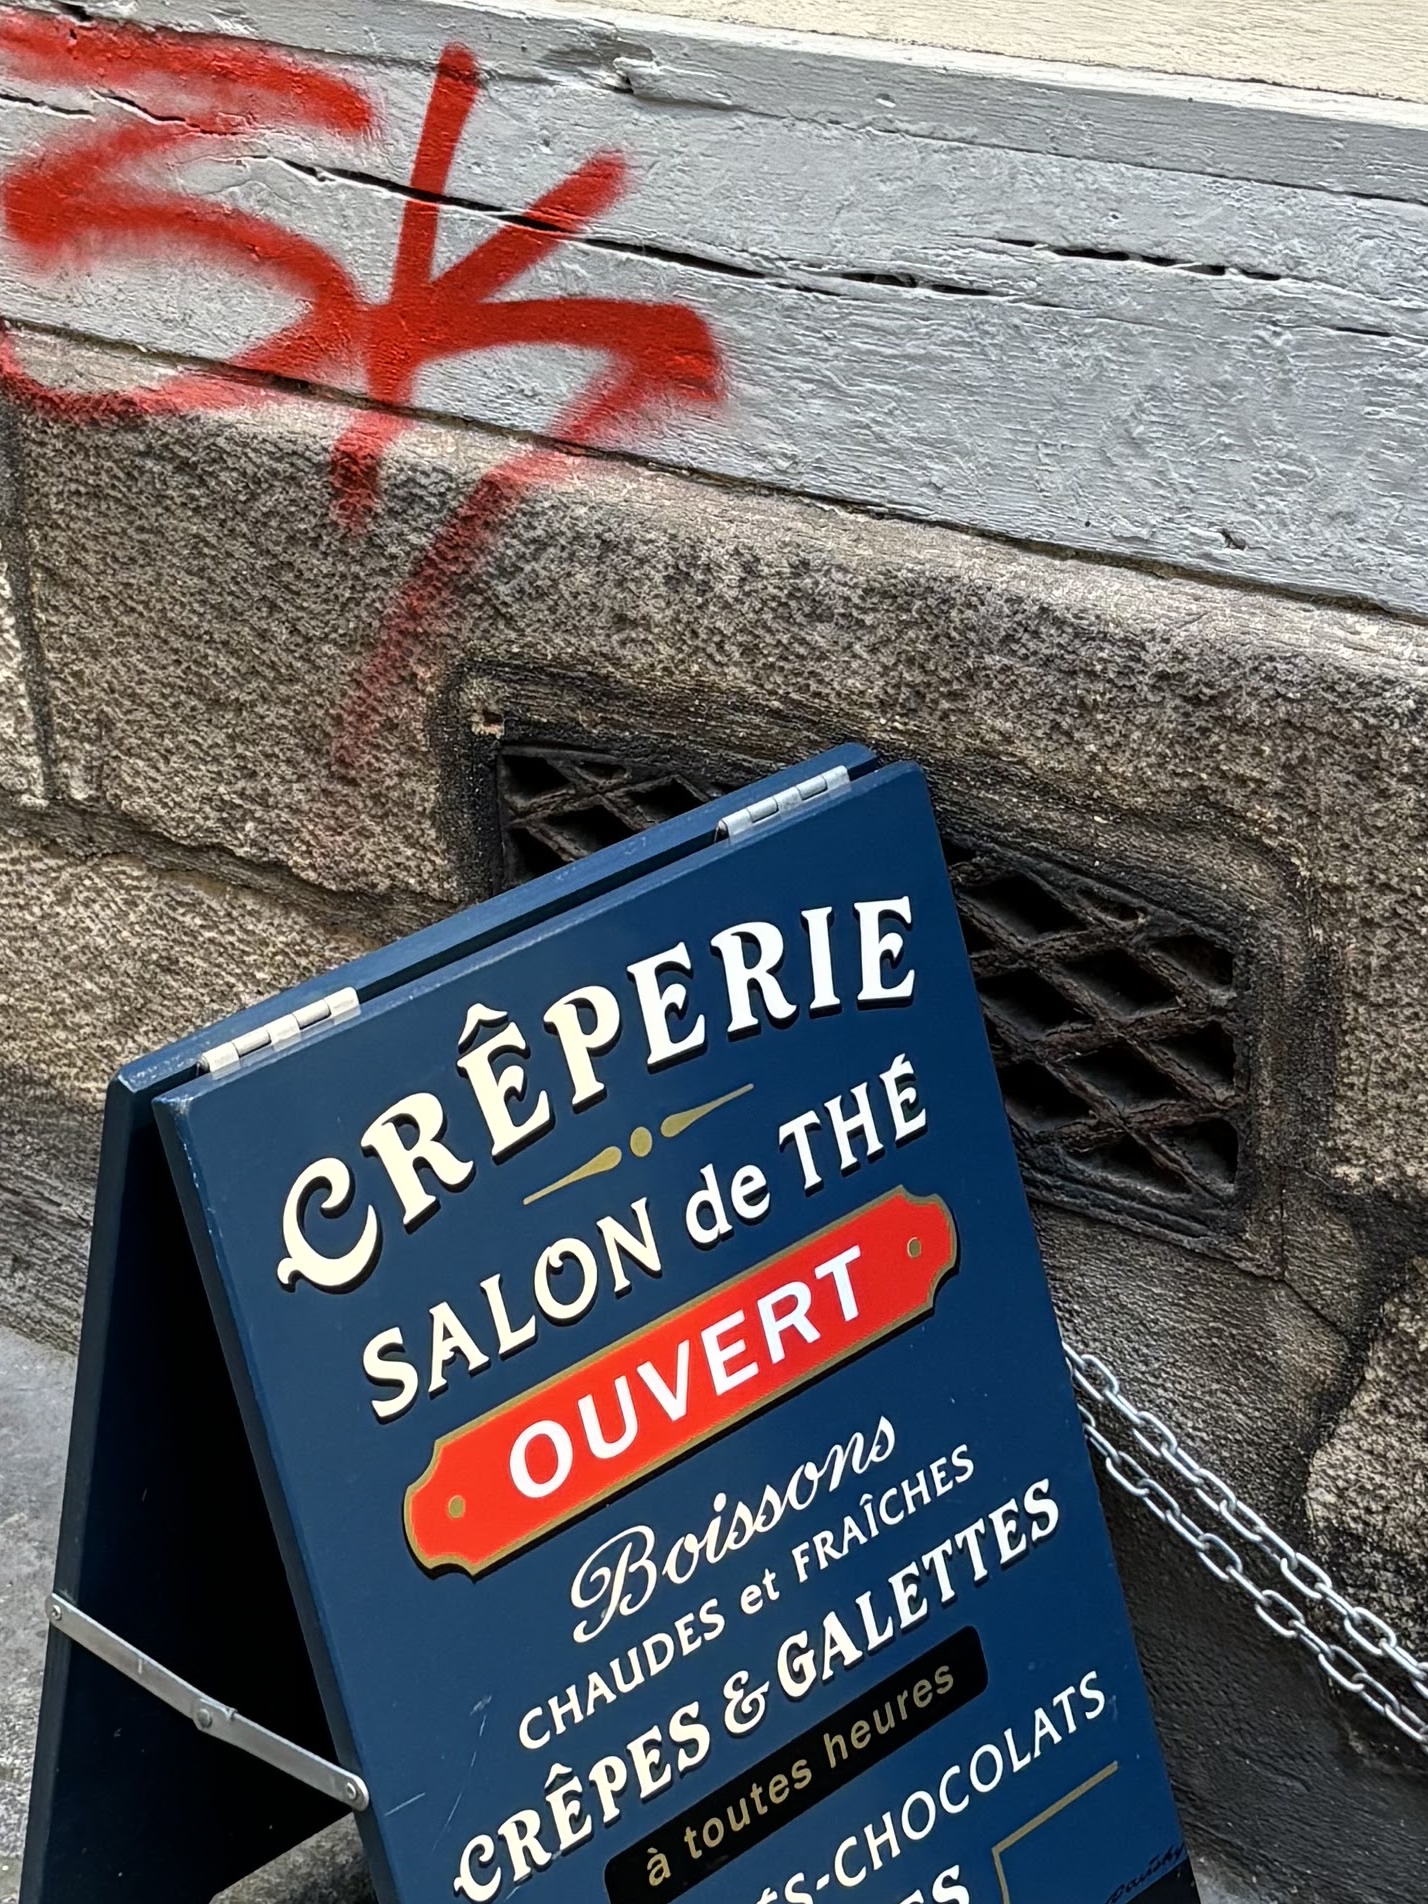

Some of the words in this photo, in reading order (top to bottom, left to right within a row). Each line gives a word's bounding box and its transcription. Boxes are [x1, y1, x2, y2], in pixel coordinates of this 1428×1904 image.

[276, 894, 917, 1290] CRÊPERIE
[362, 1196, 663, 1419] SALON
[685, 1162, 772, 1245] de
[778, 1053, 929, 1193] THÉ
[508, 1245, 863, 1499] OUVERT
[518, 1598, 726, 1750] CHAUDES
[739, 1568, 781, 1615] et
[791, 1443, 975, 1583] FRAÎCHES
[570, 1415, 896, 1644] Boissons
[452, 1701, 712, 1904] CRÊPES
[723, 1670, 771, 1736] &
[776, 1478, 1060, 1699] GALETTES
[646, 1847, 673, 1887] à
[683, 1759, 813, 1860] toutes
[822, 1664, 955, 1770] heures
